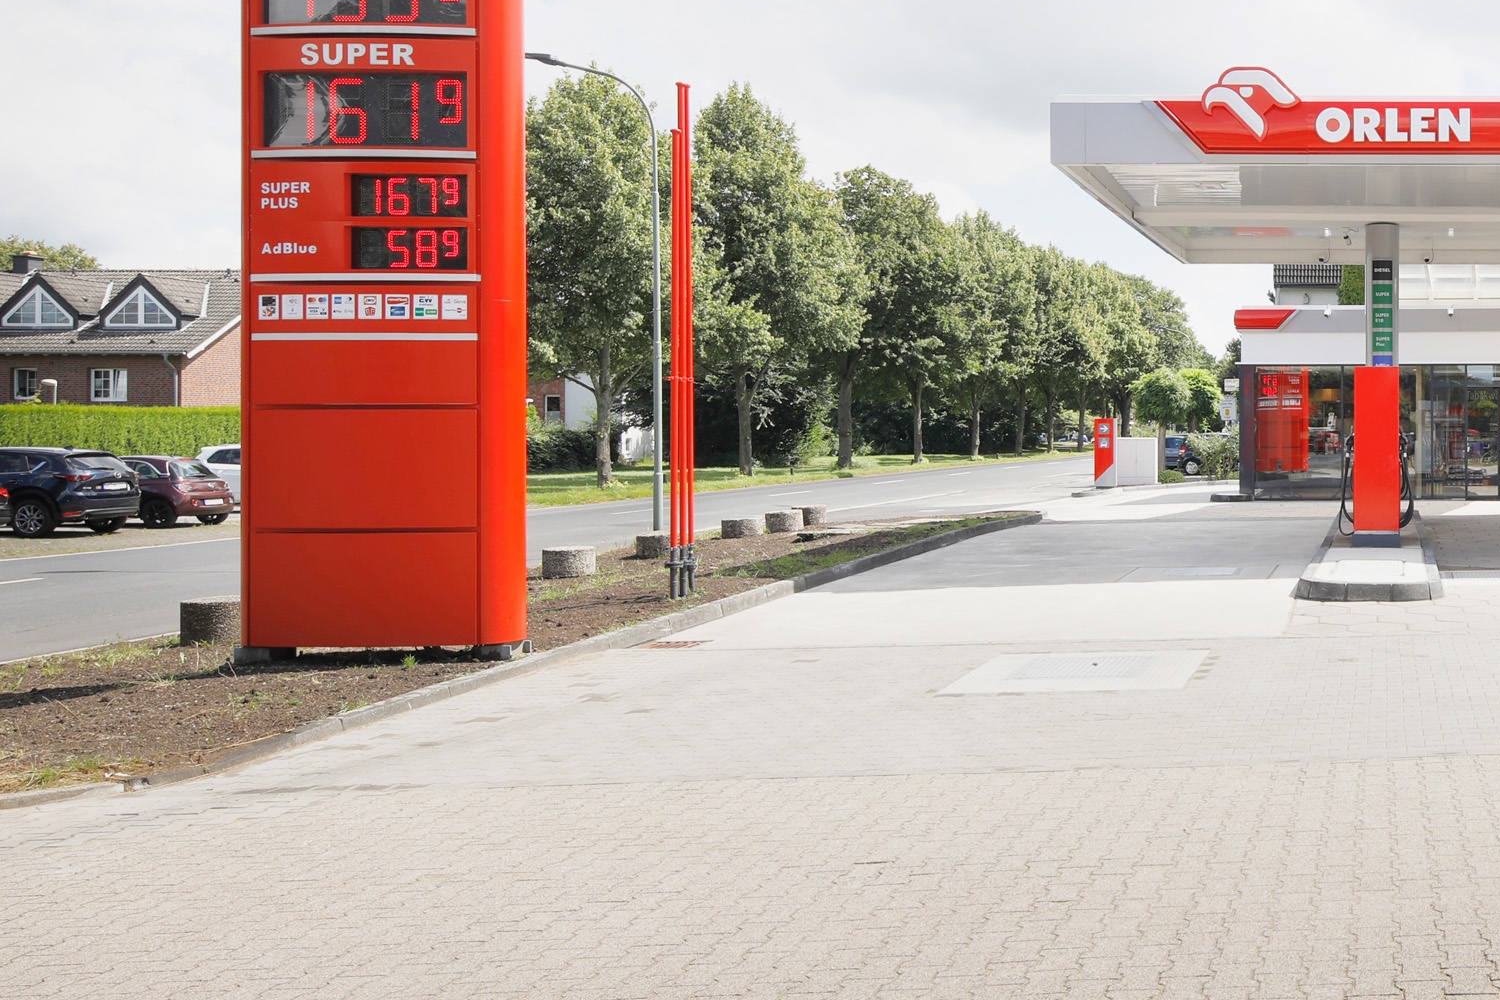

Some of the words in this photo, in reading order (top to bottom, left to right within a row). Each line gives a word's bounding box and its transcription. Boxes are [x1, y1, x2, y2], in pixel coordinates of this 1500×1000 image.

[300, 43, 415, 66] SUPER
[1315, 106, 1471, 144] ORLEN
[261, 181, 311, 195] SUPER
[261, 197, 299, 209] PLUS
[261, 242, 318, 255] AdBlue
